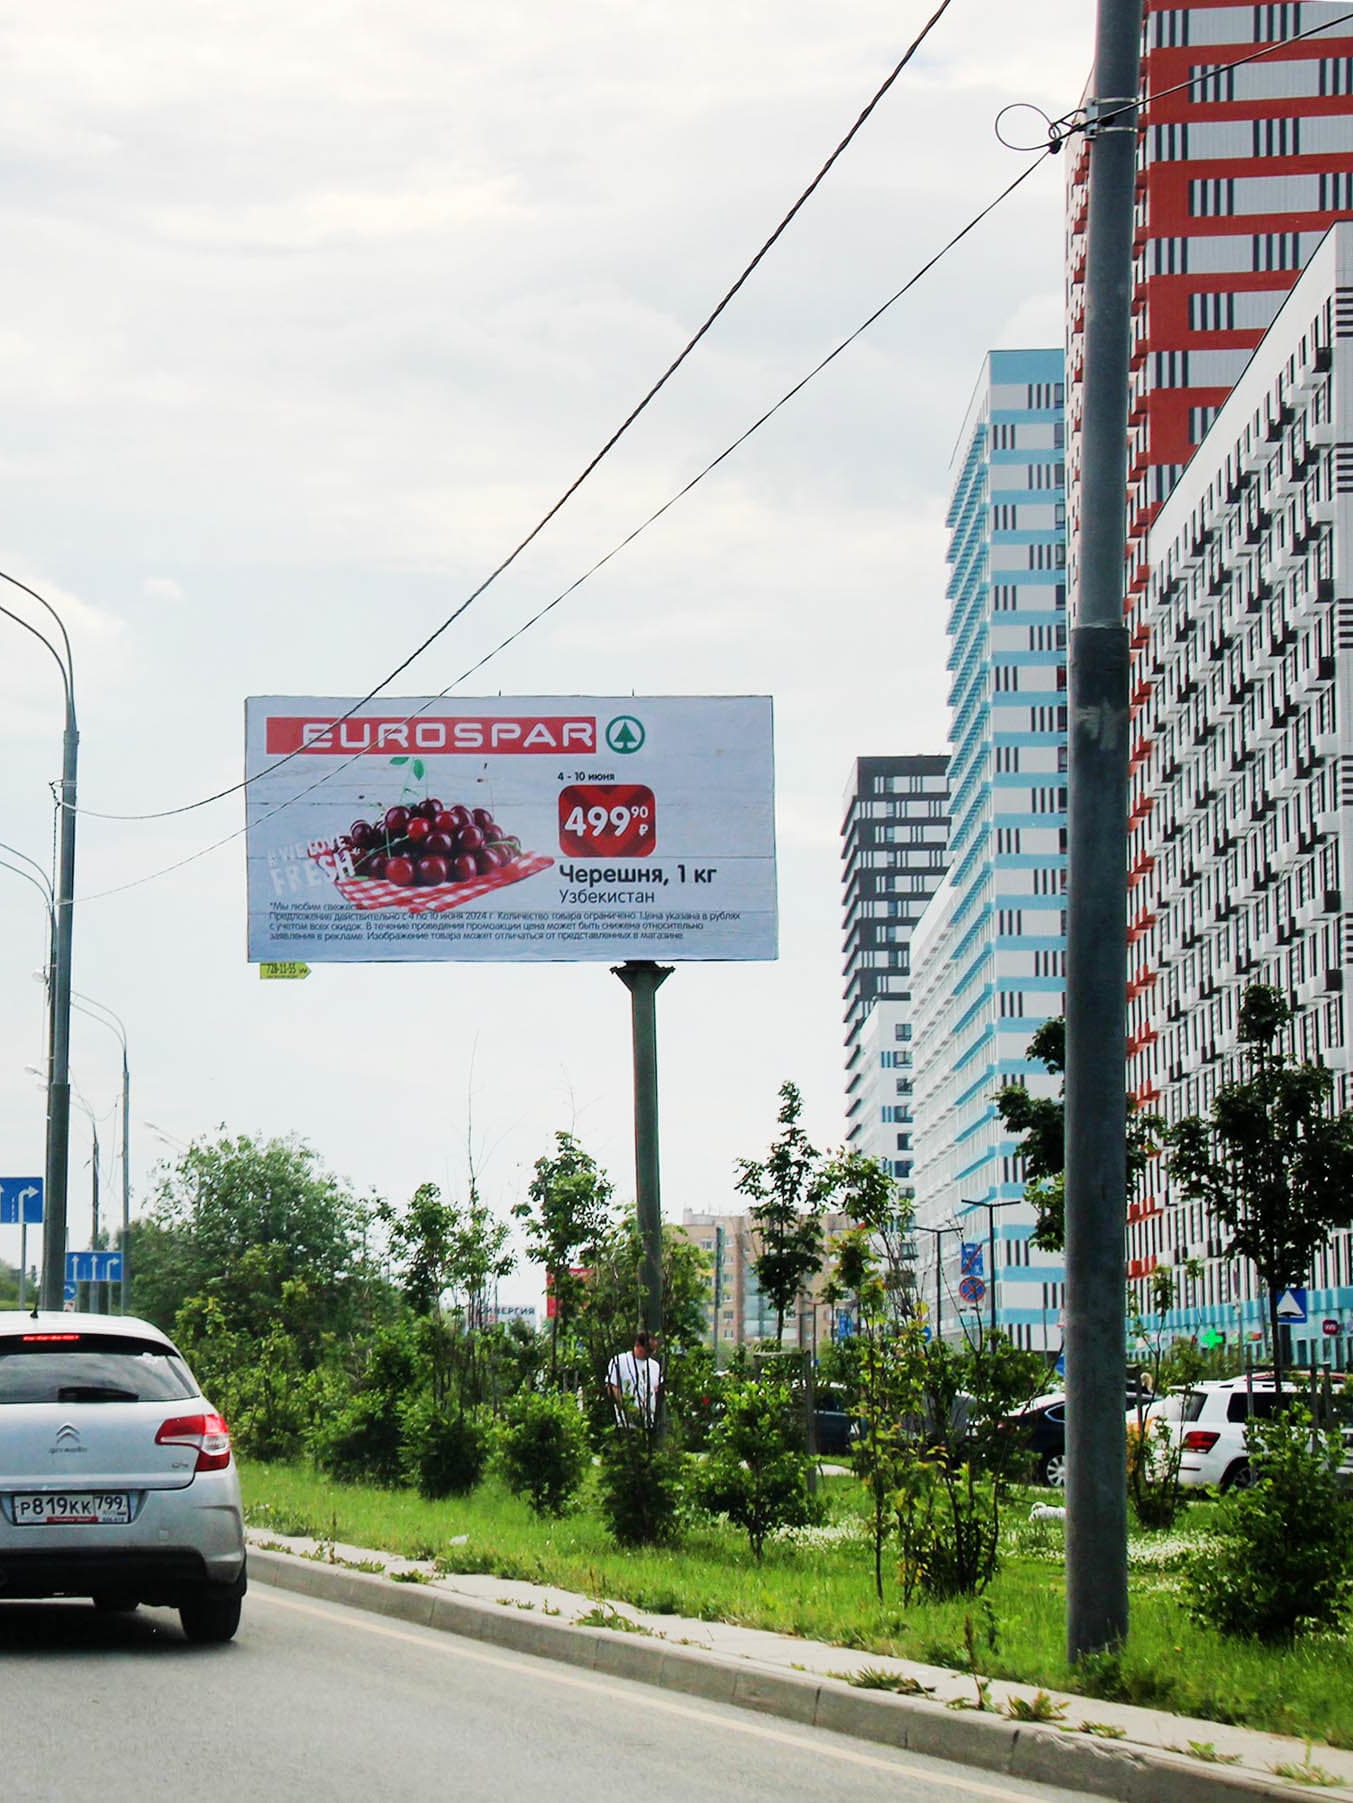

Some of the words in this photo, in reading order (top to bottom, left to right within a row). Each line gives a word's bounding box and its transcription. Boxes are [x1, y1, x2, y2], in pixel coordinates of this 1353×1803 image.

[302, 721, 593, 750] EUROSPAR
[556, 771, 565, 781] 4
[574, 771, 586, 781] 10
[588, 773, 615, 781] июня
[564, 806, 631, 837] 499
[631, 805, 649, 819] 90
[559, 864, 670, 888] Черешня,
[677, 864, 686, 883] 1
[694, 868, 718, 884] кг
[559, 888, 655, 905] Узбекистан
[270, 912, 332, 921] Предложение
[333, 912, 400, 921] действительно
[465, 912, 487, 920] 2024
[498, 912, 549, 920] Количество
[551, 913, 582, 921] товара
[639, 912, 664, 921] Цена
[665, 913, 700, 921] указана
[709, 912, 741, 921] рублях
[523, 923, 545, 931] цена
[578, 922, 600, 930] быть
[19, 1496, 92, 1516] Р819КК
[95, 1495, 124, 1510] 799
